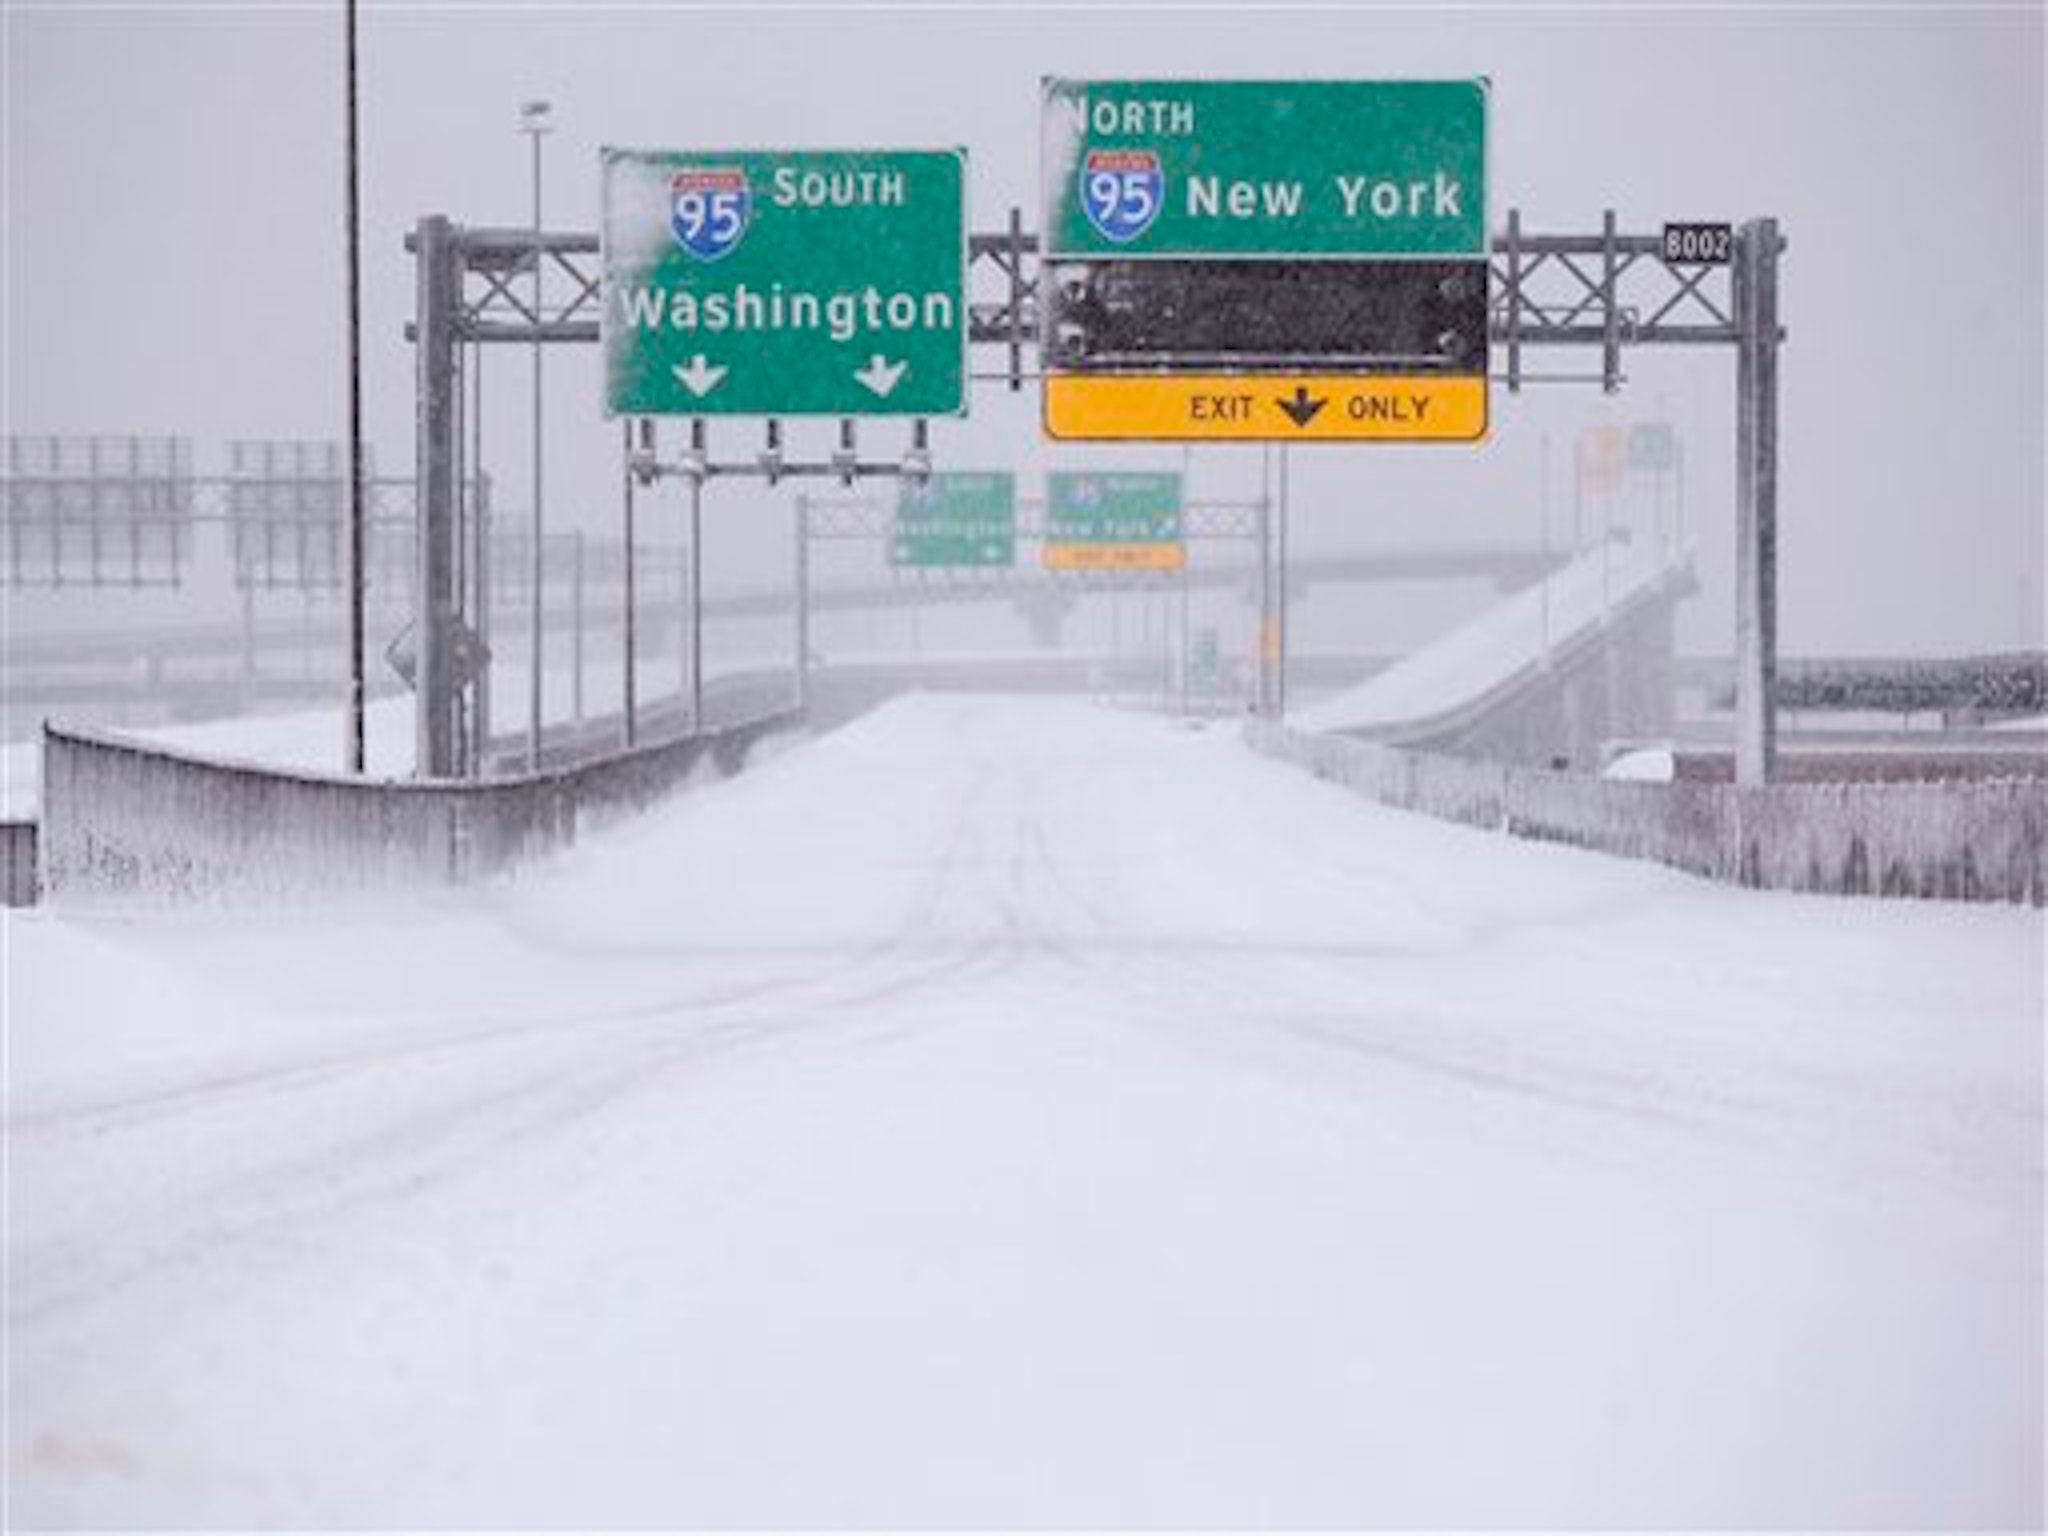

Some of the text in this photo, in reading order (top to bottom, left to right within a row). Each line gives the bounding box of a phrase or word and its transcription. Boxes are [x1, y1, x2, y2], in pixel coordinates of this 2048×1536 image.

[772, 167, 906, 208] SOUTH
[1088, 173, 1154, 224] 95
[1186, 170, 1463, 217] New York
[674, 193, 743, 243] 95
[1666, 229, 1729, 260] 8002
[619, 283, 954, 341] Washington
[1190, 394, 1430, 421] EXIT ONLY
